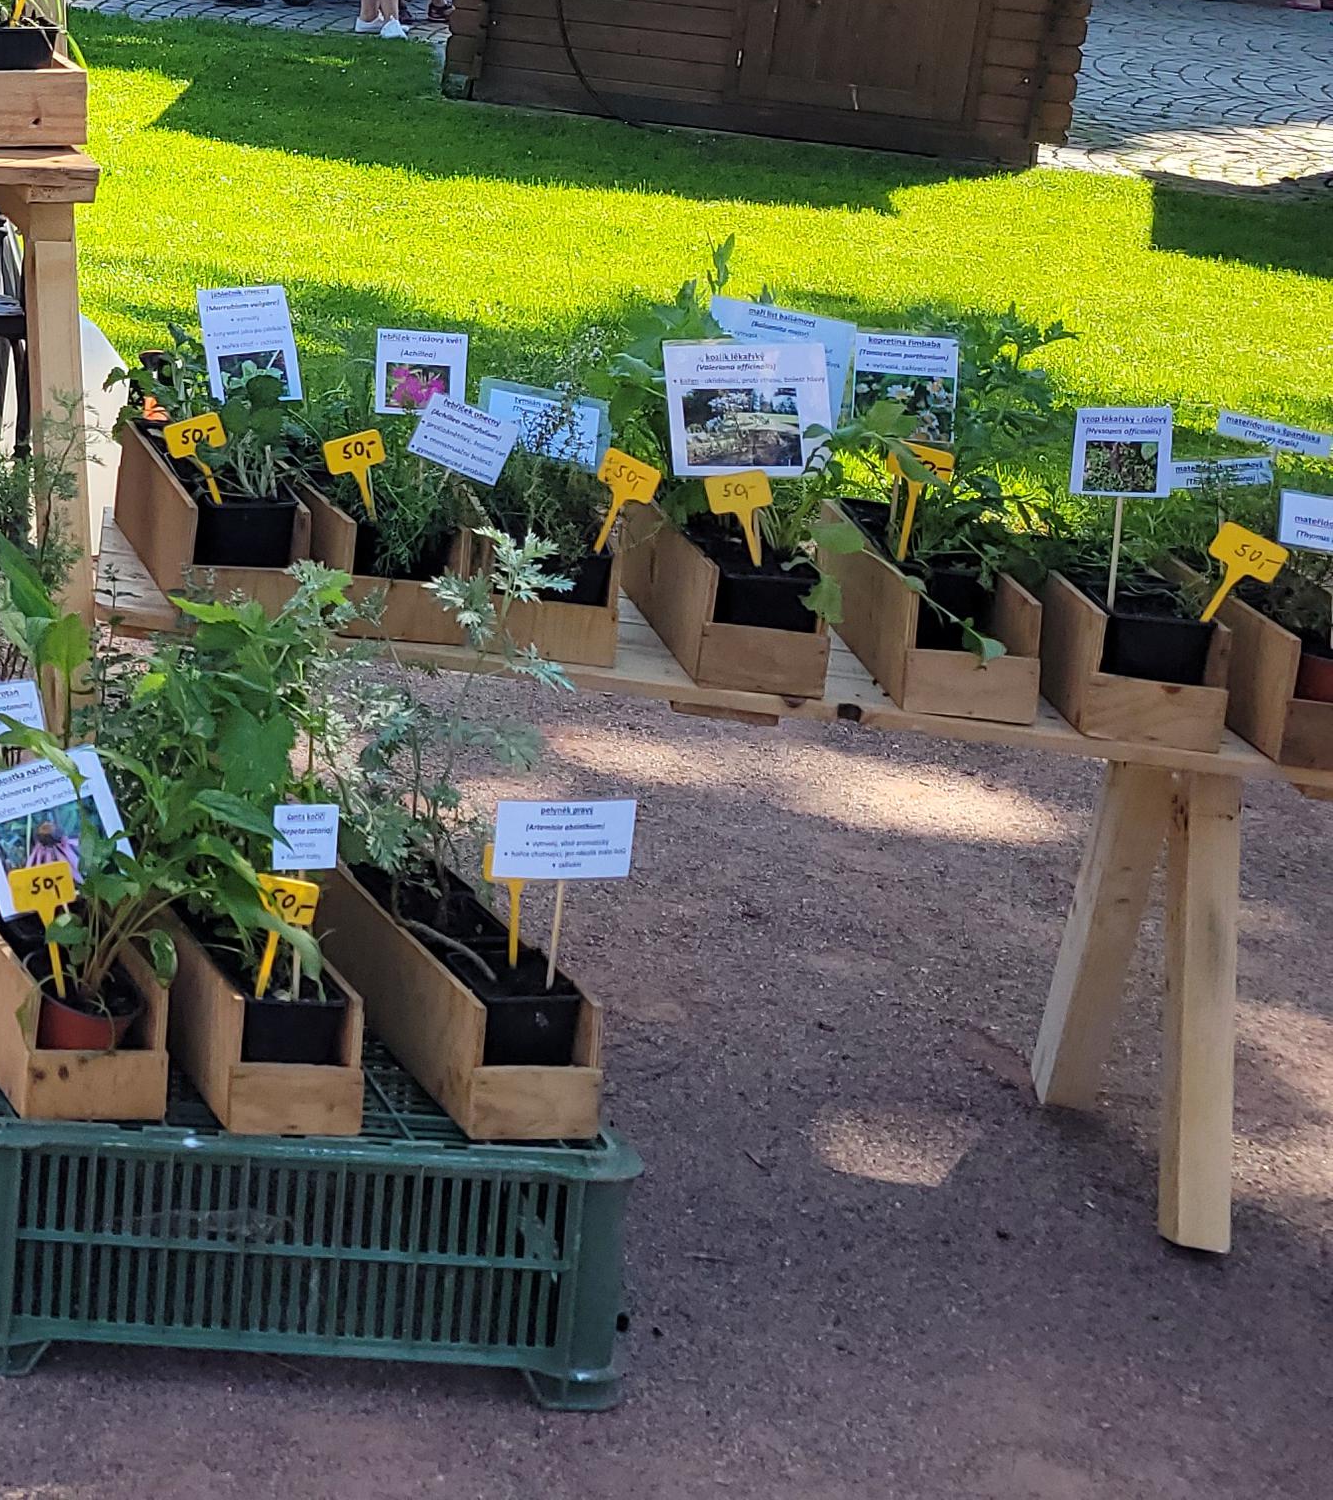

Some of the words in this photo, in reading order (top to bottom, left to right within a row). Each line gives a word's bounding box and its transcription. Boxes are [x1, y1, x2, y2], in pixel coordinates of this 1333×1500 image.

[868, 336, 906, 346] kopretina
[730, 352, 765, 362] lékařský
[27, 763, 55, 779] nachov
[540, 806, 571, 816] pelyněk
[572, 805, 594, 816] pravý
